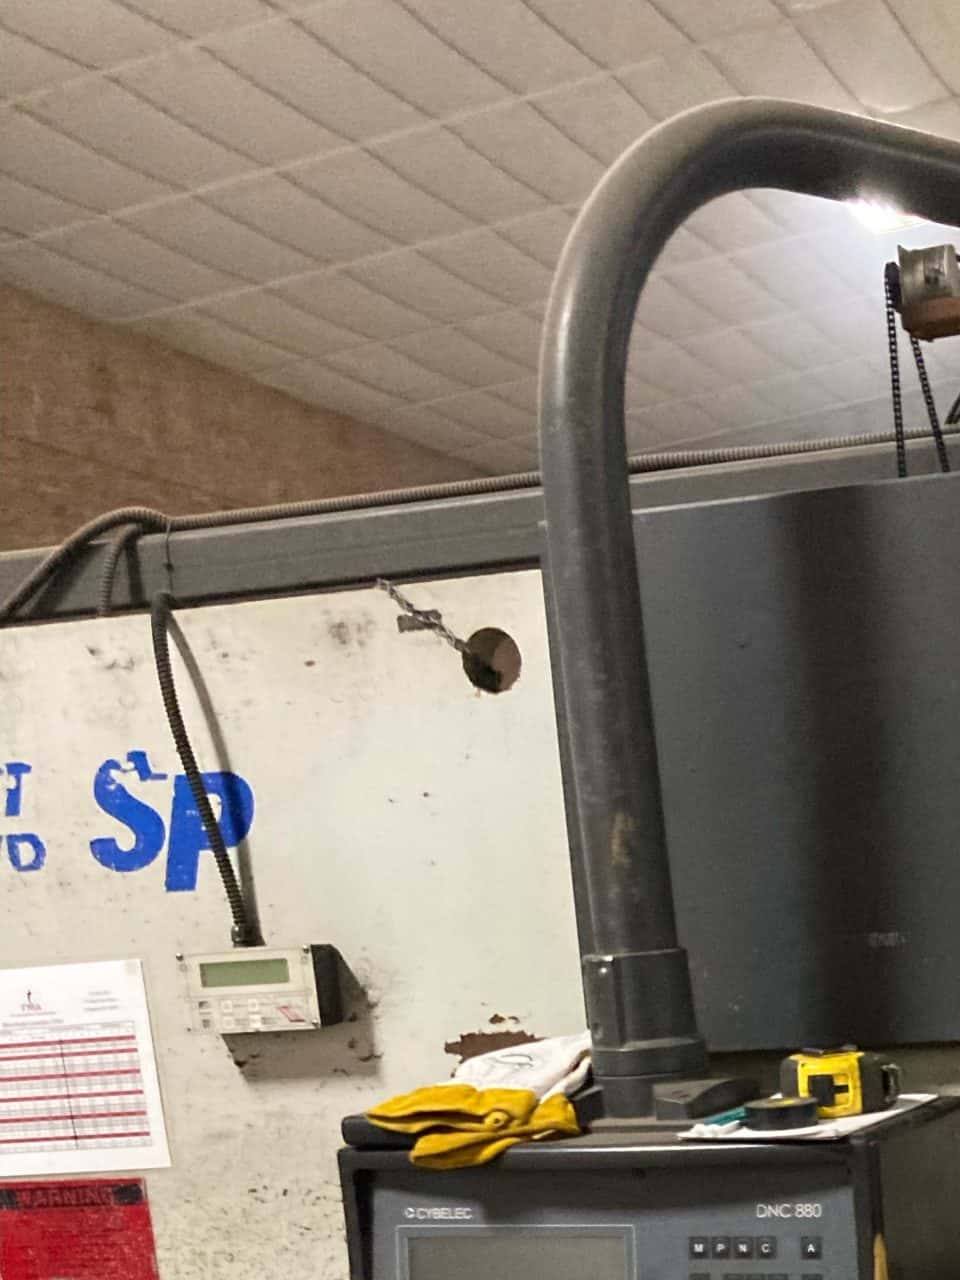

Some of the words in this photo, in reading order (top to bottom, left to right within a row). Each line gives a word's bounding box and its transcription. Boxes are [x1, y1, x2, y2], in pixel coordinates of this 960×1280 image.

[0, 762, 32, 816] T
[89, 750, 255, 892] SP
[416, 1207, 473, 1220] CYBELEC
[756, 1203, 792, 1219] DNC
[794, 1203, 823, 1219] 880
